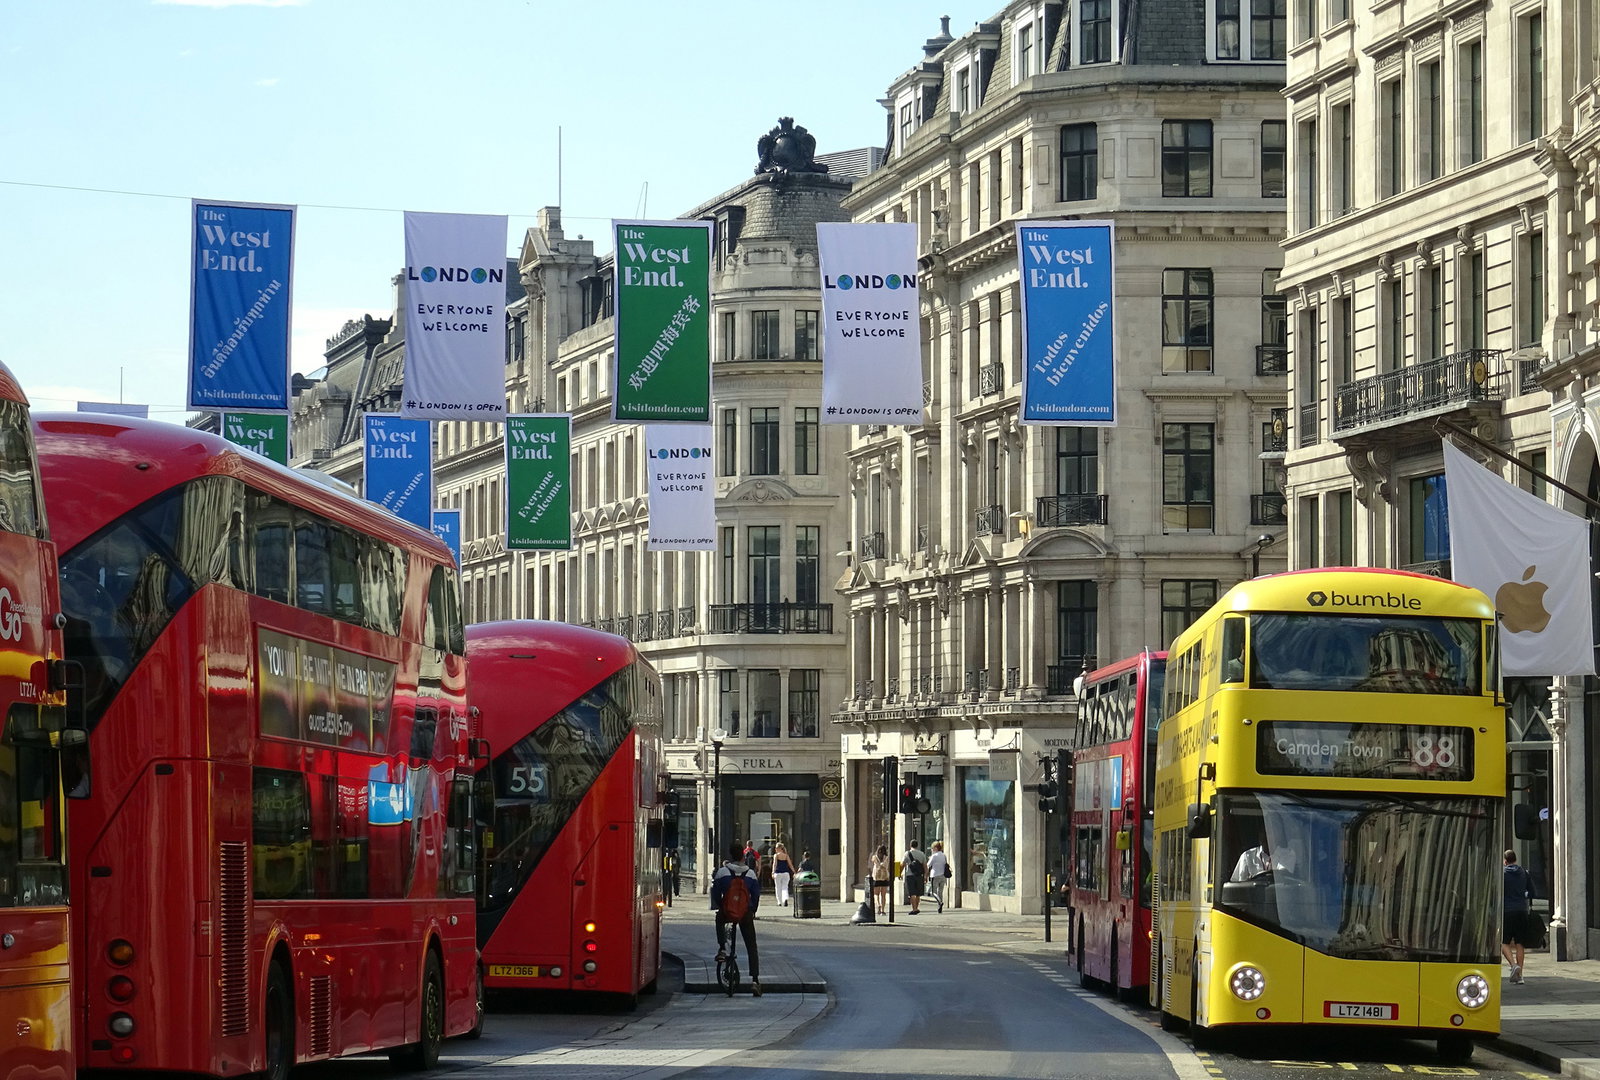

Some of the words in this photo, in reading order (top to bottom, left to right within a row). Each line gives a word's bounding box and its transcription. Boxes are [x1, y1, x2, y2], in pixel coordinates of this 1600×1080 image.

[201, 209, 226, 222] The
[202, 225, 271, 249] West
[621, 229, 645, 241] The
[1026, 232, 1049, 242] The
[201, 249, 263, 273] End.
[623, 243, 691, 264] West
[1028, 245, 1094, 265] West
[408, 266, 503, 284] LONDON
[623, 266, 684, 288] End.
[825, 273, 916, 290] LONDON
[1030, 267, 1089, 288] End.
[417, 303, 494, 316] EVERYONE
[836, 310, 910, 321] EVERYONE
[423, 321, 489, 333] WELCOME
[841, 327, 905, 338] WELCOME
[627, 294, 701, 391] 欢迎四海宾客
[1046, 301, 1109, 387] bienvenidos
[1033, 331, 1068, 374] Todos
[197, 389, 281, 402] visitlondon.com
[622, 403, 704, 414] visitlondon.com
[1030, 403, 1110, 413] visitlondon.com
[228, 415, 244, 423] The
[370, 419, 386, 427] The
[228, 425, 274, 440] West
[370, 428, 417, 443] West
[511, 430, 557, 444] West
[370, 444, 413, 459] End.
[511, 445, 553, 460] End.
[649, 447, 711, 459] LONDON
[657, 473, 706, 481] EVERYONE
[517, 470, 555, 519] Everyone
[529, 480, 563, 525] welcome
[511, 537, 568, 545] visitlondon.com
[1331, 590, 1422, 610] bumble
[303, 655, 314, 683] BE
[346, 666, 355, 693] IN
[20, 681, 37, 698] LT274
[1044, 738, 1070, 747] MOLTON
[1276, 738, 1338, 757] Camden
[1344, 741, 1384, 758] Town
[1415, 735, 1455, 768] 88
[743, 759, 784, 769] FURLA
[510, 767, 544, 793] 55
